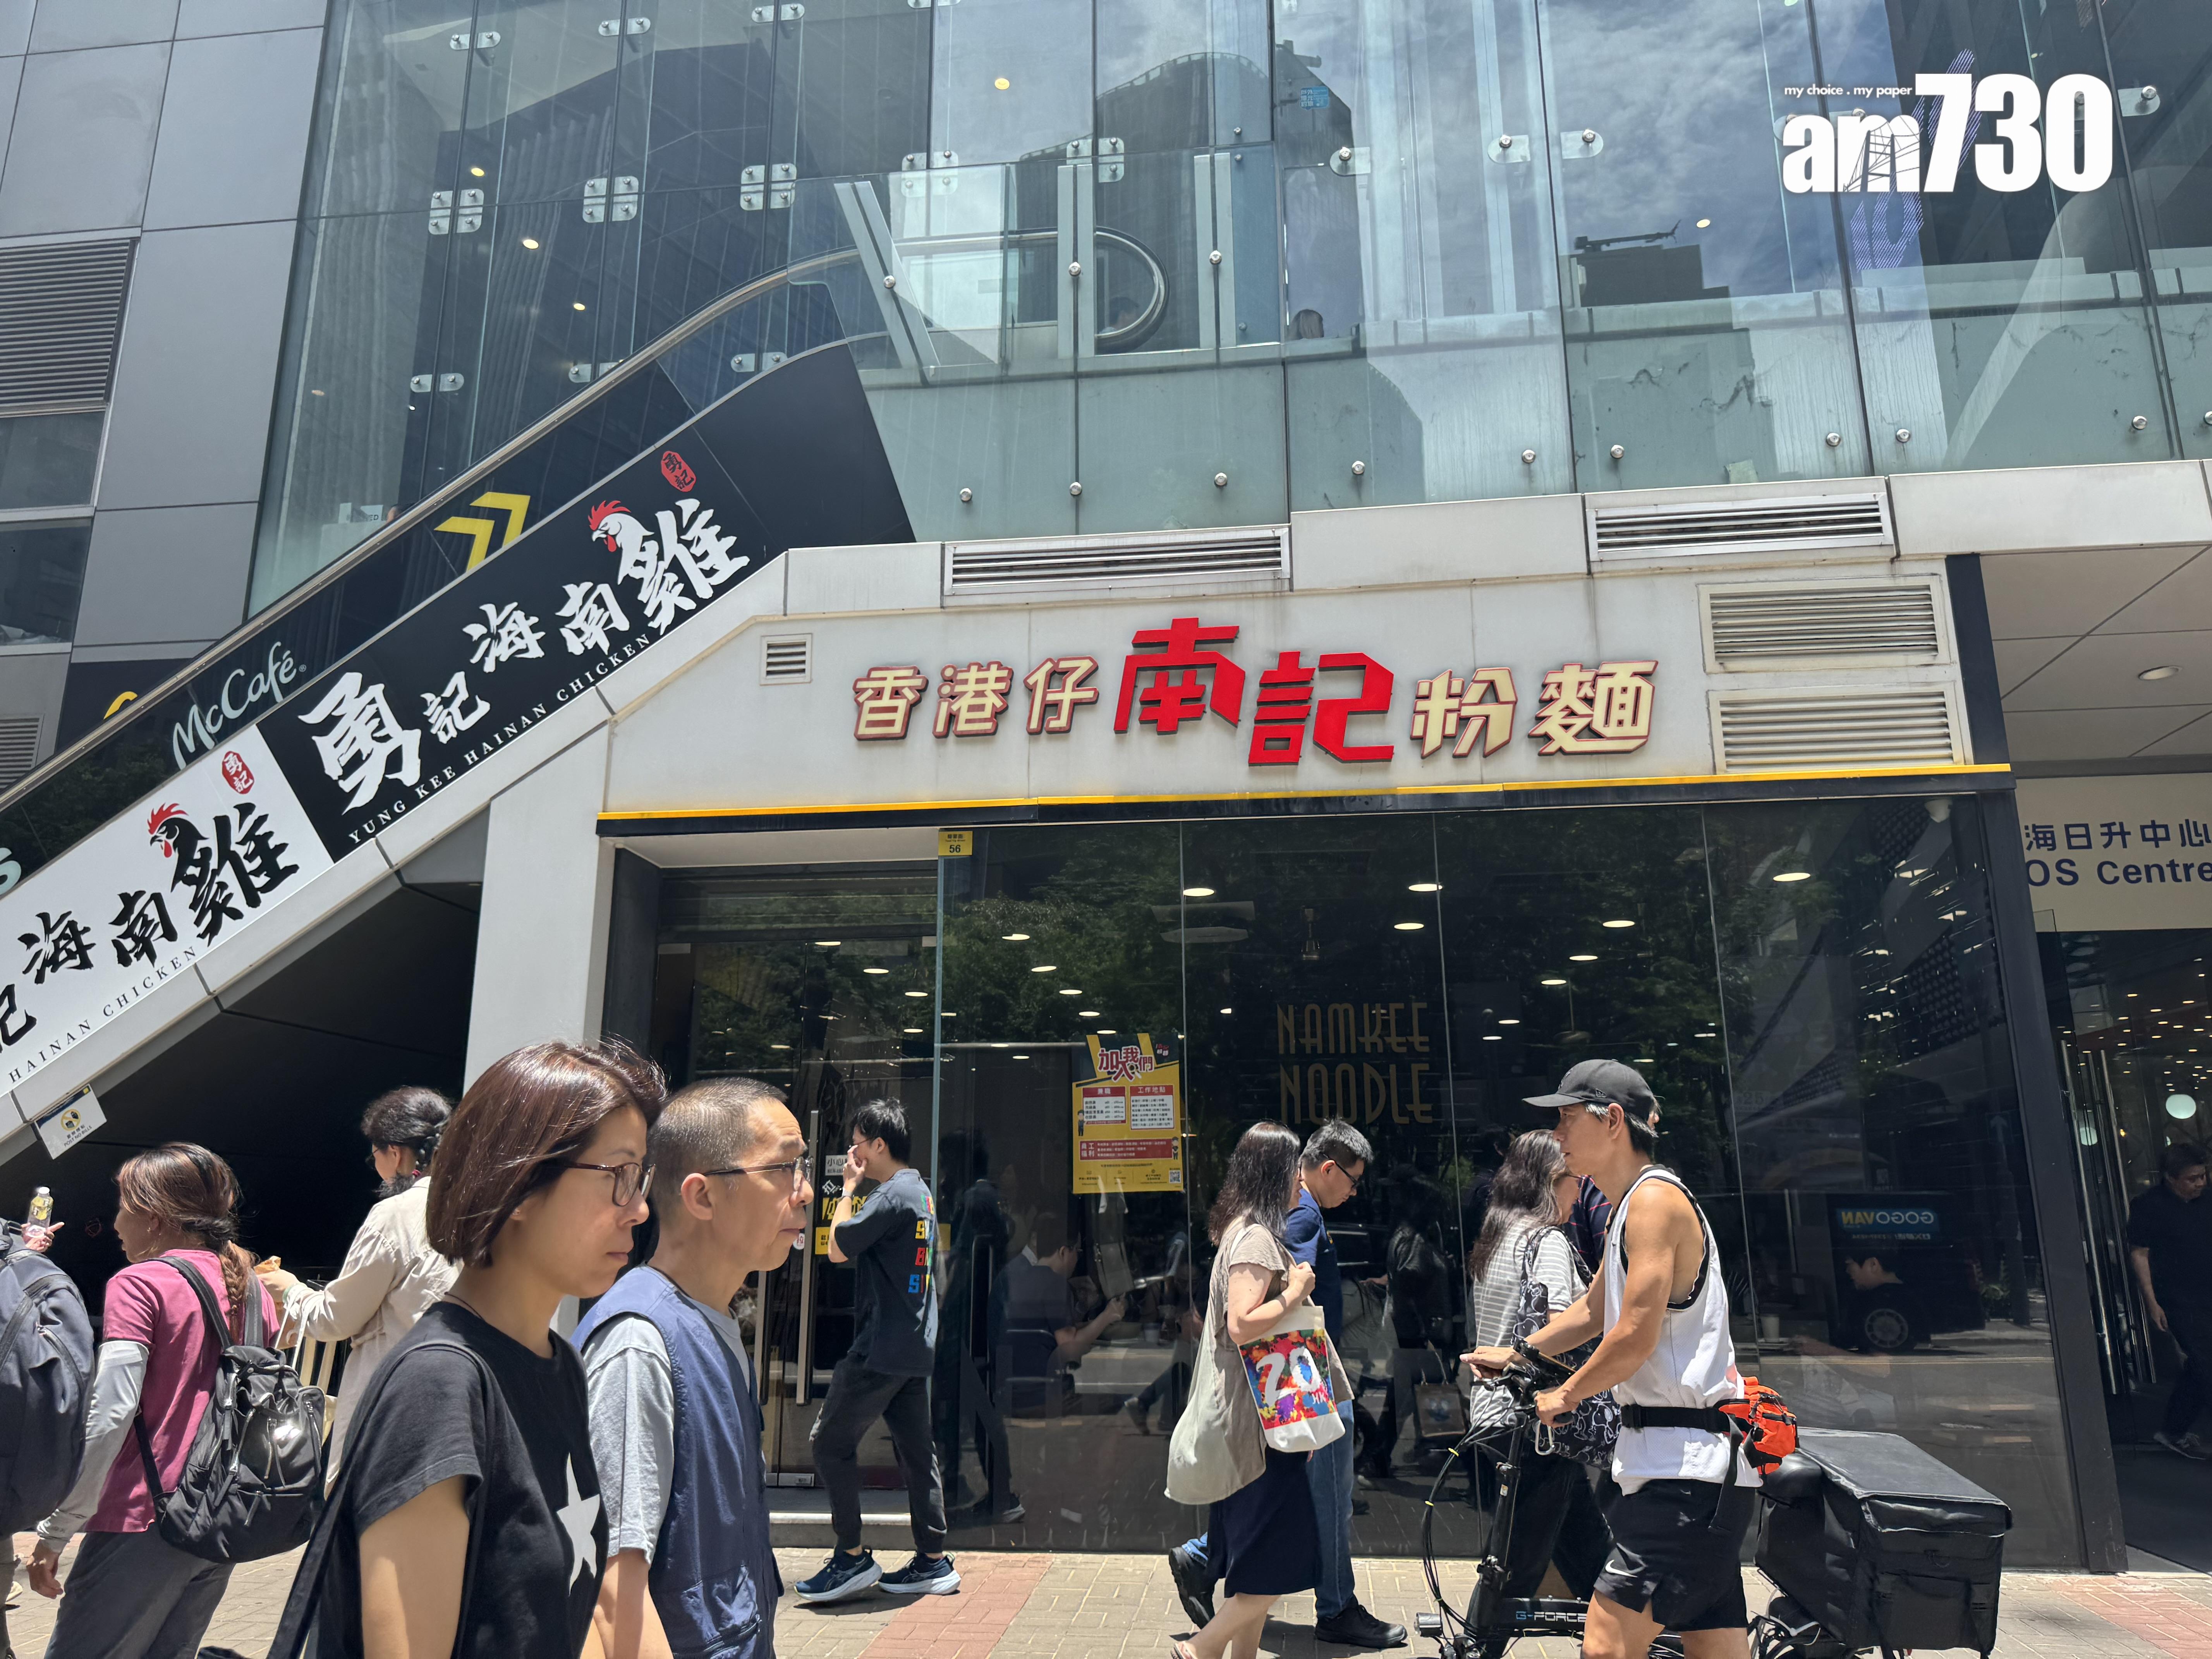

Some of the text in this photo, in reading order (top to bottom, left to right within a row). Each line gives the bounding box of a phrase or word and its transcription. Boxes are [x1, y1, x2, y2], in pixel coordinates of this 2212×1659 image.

[663, 453, 694, 489] 勇記
[852, 617, 1660, 766] 香港仔南記粉麵
[349, 633, 651, 845] YUNG KEE HAINAN CHICKEN
[224, 753, 254, 793] 勇記
[949, 844, 961, 853] 56
[2024, 819, 2212, 851] 海日升中心
[2097, 859, 2212, 885] Centre
[8, 946, 197, 1084] HAINAN CHICKEN
[1279, 1062, 1433, 1124] NOODLE
[64, 1137, 74, 1147] POST
[1516, 1611, 1587, 1622] G-FORCE
